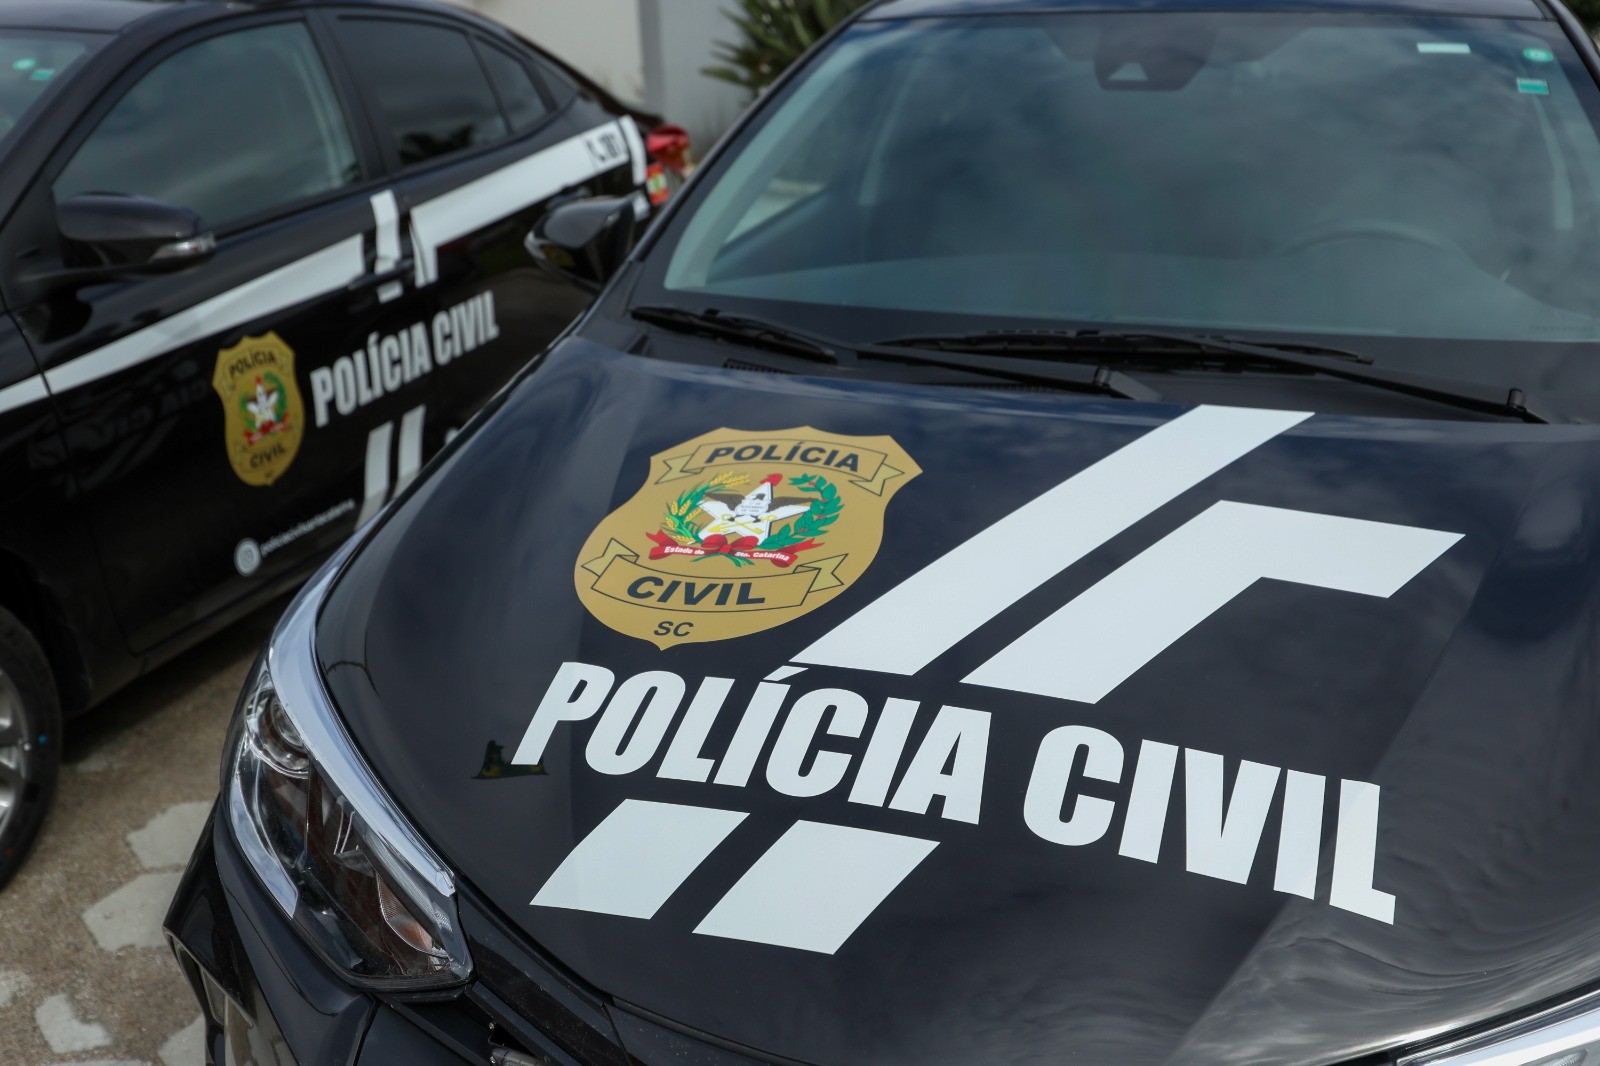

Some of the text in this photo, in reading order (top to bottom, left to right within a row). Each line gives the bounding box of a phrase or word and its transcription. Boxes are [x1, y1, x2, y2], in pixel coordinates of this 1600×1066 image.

[229, 350, 277, 378] POLÍCIA
[310, 290, 499, 428] POLÍCIA CIVIL
[249, 443, 286, 469] CIVIL
[705, 440, 860, 473] POLÍCIA
[626, 576, 766, 606] CIVIL
[653, 620, 694, 637] SC
[510, 661, 1396, 926] POLÍCIA CIVIL
